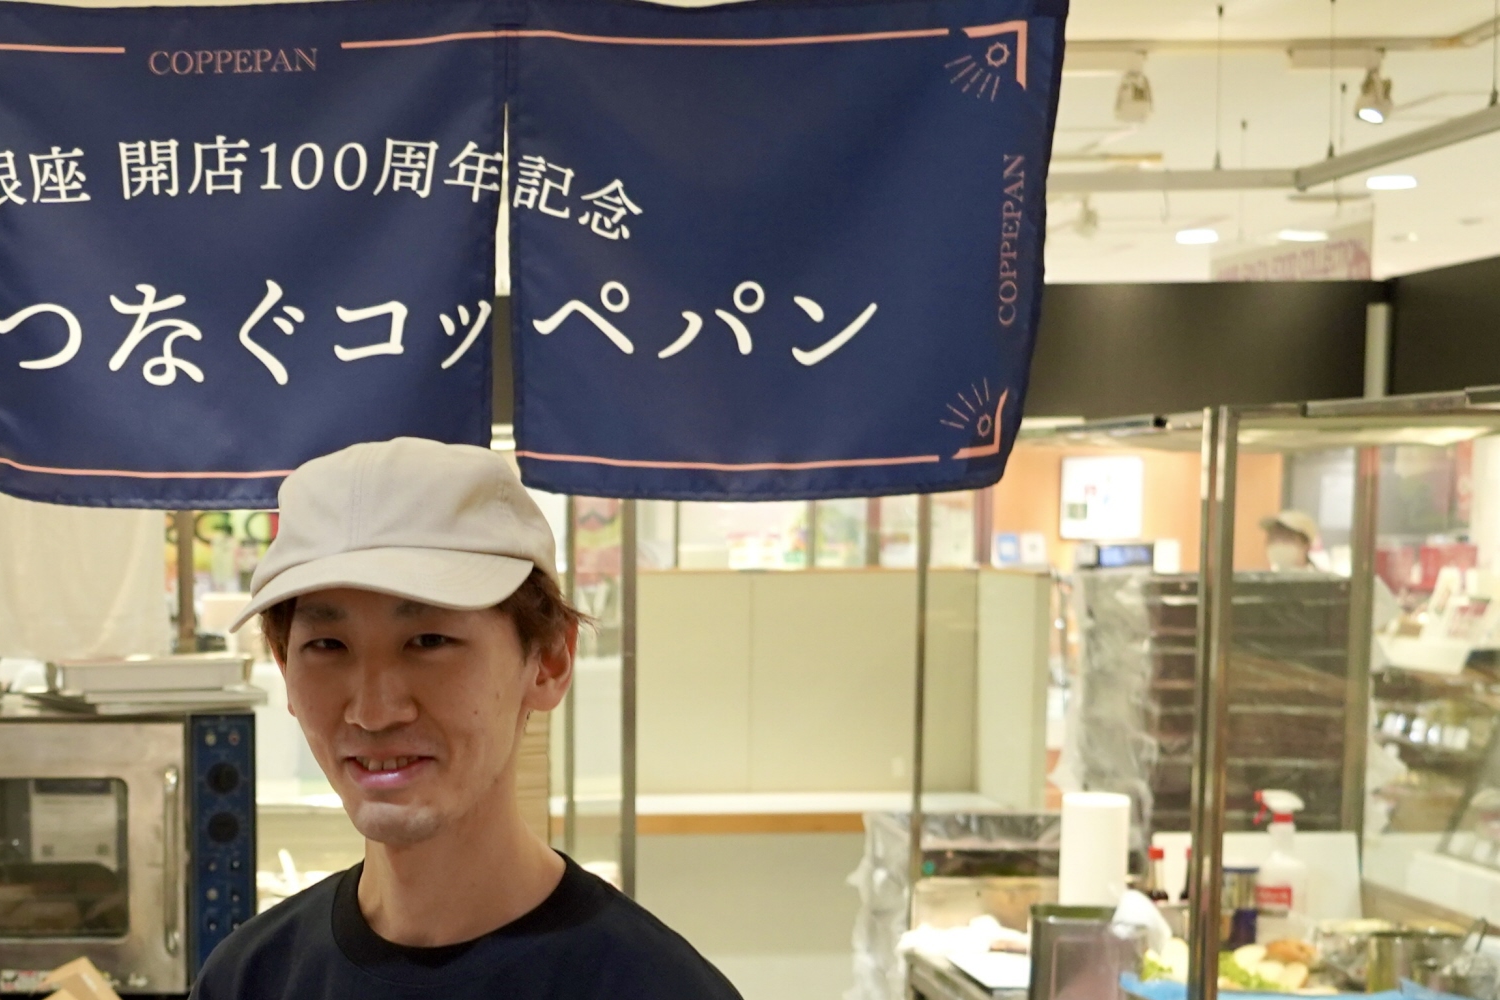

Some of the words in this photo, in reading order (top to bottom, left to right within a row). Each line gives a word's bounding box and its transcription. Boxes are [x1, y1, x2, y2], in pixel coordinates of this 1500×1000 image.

[148, 48, 318, 76] COPPEPAN
[118, 135, 643, 241] 開店100周年記念
[997, 153, 1027, 327] COPPEPAN
